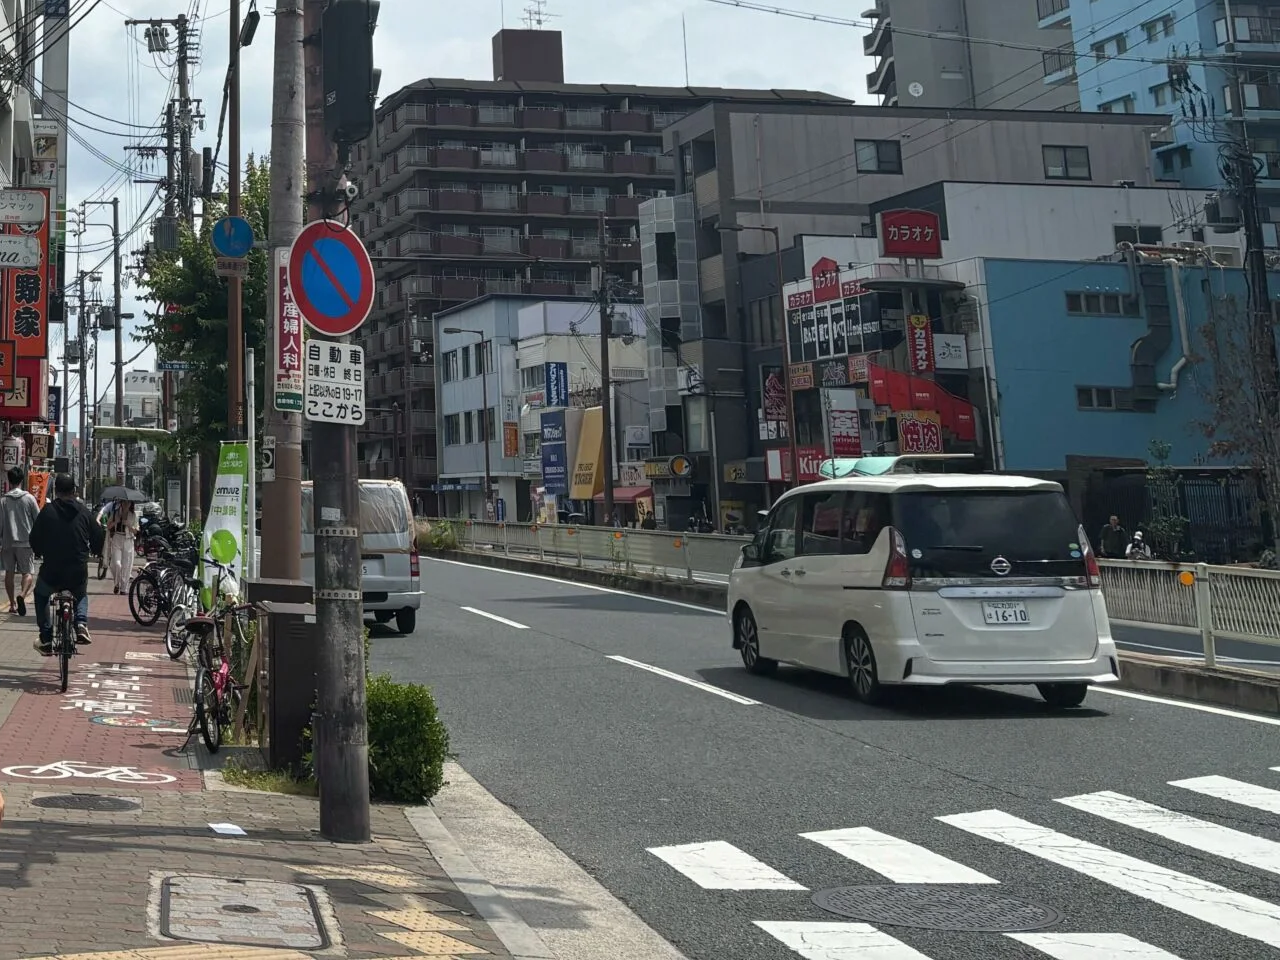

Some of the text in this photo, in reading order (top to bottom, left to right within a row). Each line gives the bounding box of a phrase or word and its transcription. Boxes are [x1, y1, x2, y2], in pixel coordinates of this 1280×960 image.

[9, 193, 27, 201] LTD
[888, 225, 934, 242] カラオケ
[815, 271, 837, 289] カラオケ
[843, 281, 867, 295] カラオ
[13, 270, 41, 338] 野家
[789, 294, 812, 307] カラオケ
[282, 272, 299, 368] 産婦人科
[308, 343, 363, 366] 自動車
[914, 328, 928, 370] カラオケ
[308, 364, 362, 382] 日曜・休日 終日
[307, 385, 341, 400] 上記以外の日
[342, 387, 363, 402] 19-17
[307, 400, 364, 421] ここから
[831, 410, 859, 436] 薬
[900, 418, 943, 454] 焼肉
[799, 455, 823, 475] Kiri
[995, 609, 1027, 622] 16-10
